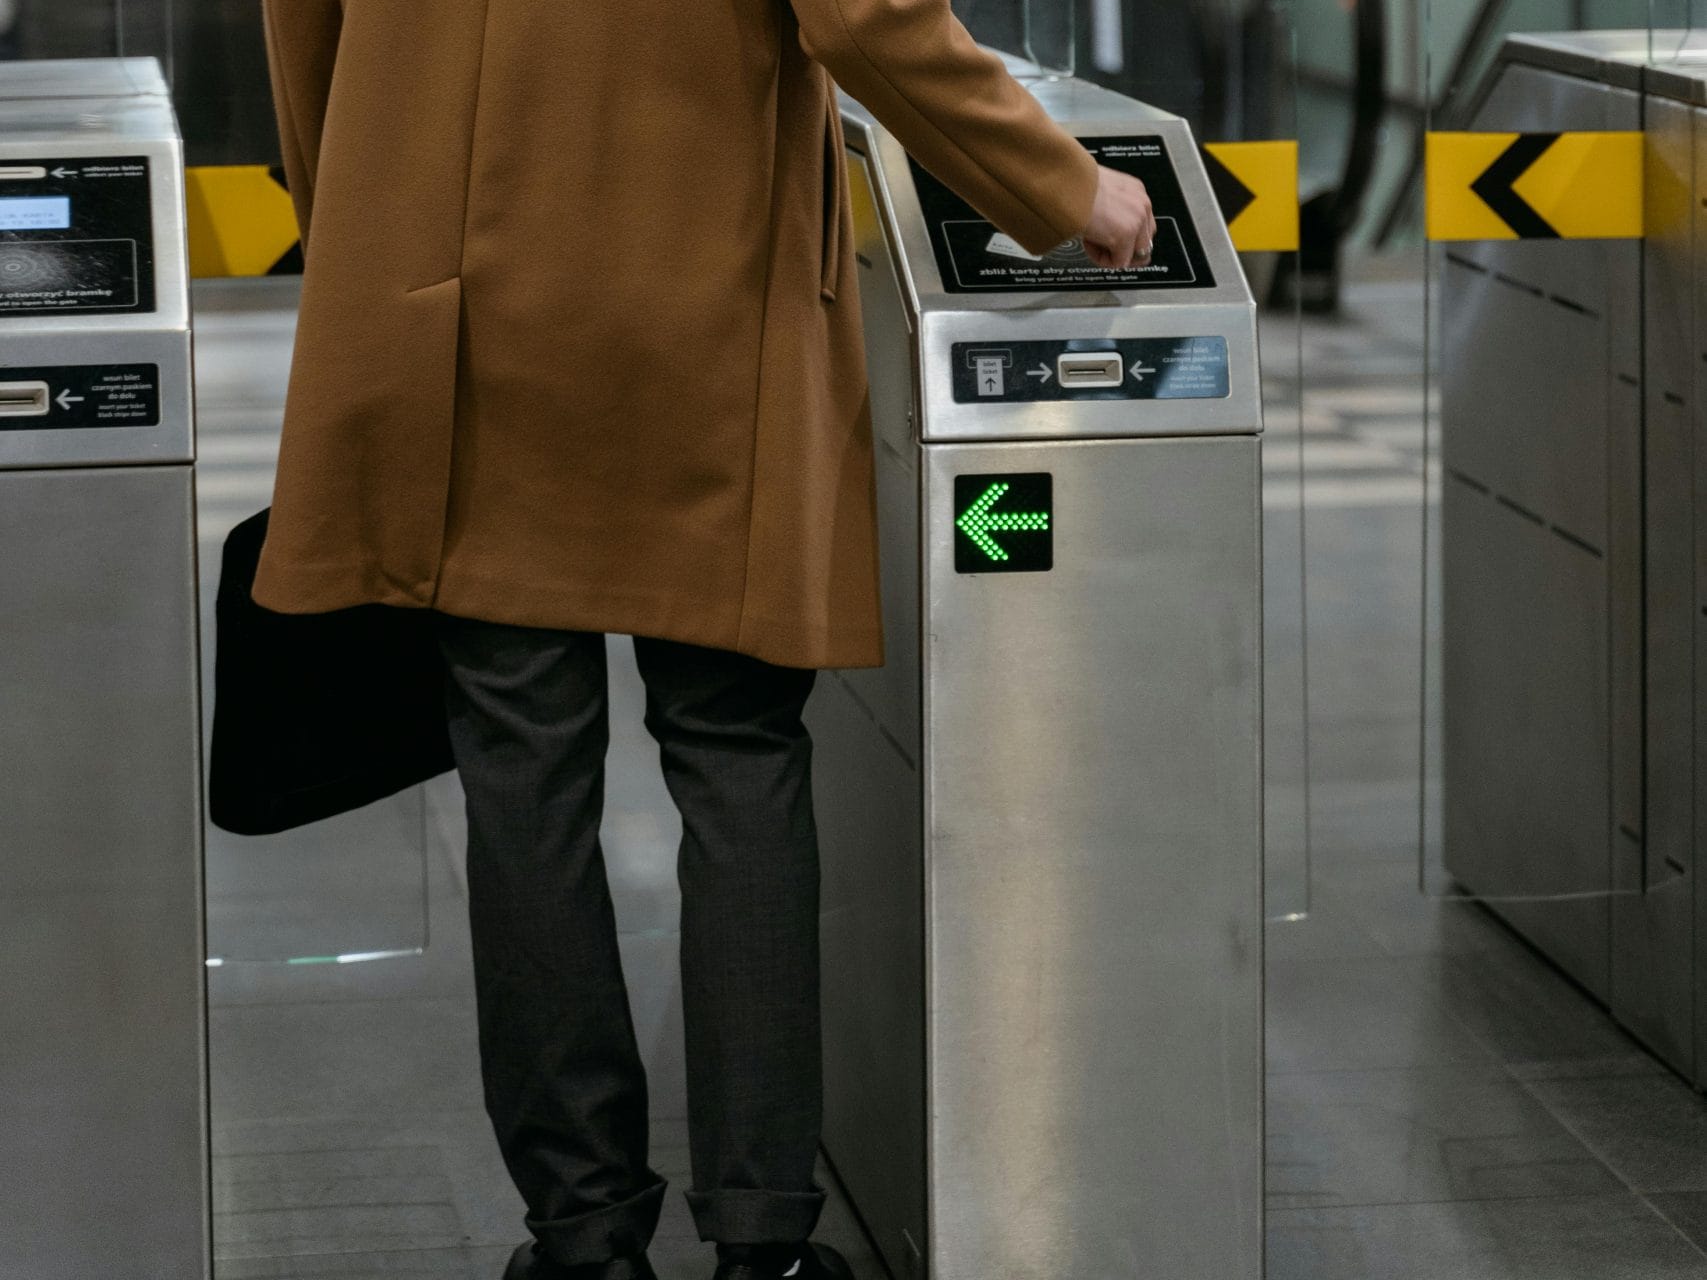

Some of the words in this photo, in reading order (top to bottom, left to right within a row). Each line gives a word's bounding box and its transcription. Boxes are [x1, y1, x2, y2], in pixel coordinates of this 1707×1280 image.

[1009, 268, 1040, 276] kartę
[1043, 267, 1065, 275] aby
[66, 289, 113, 297] bramkę
